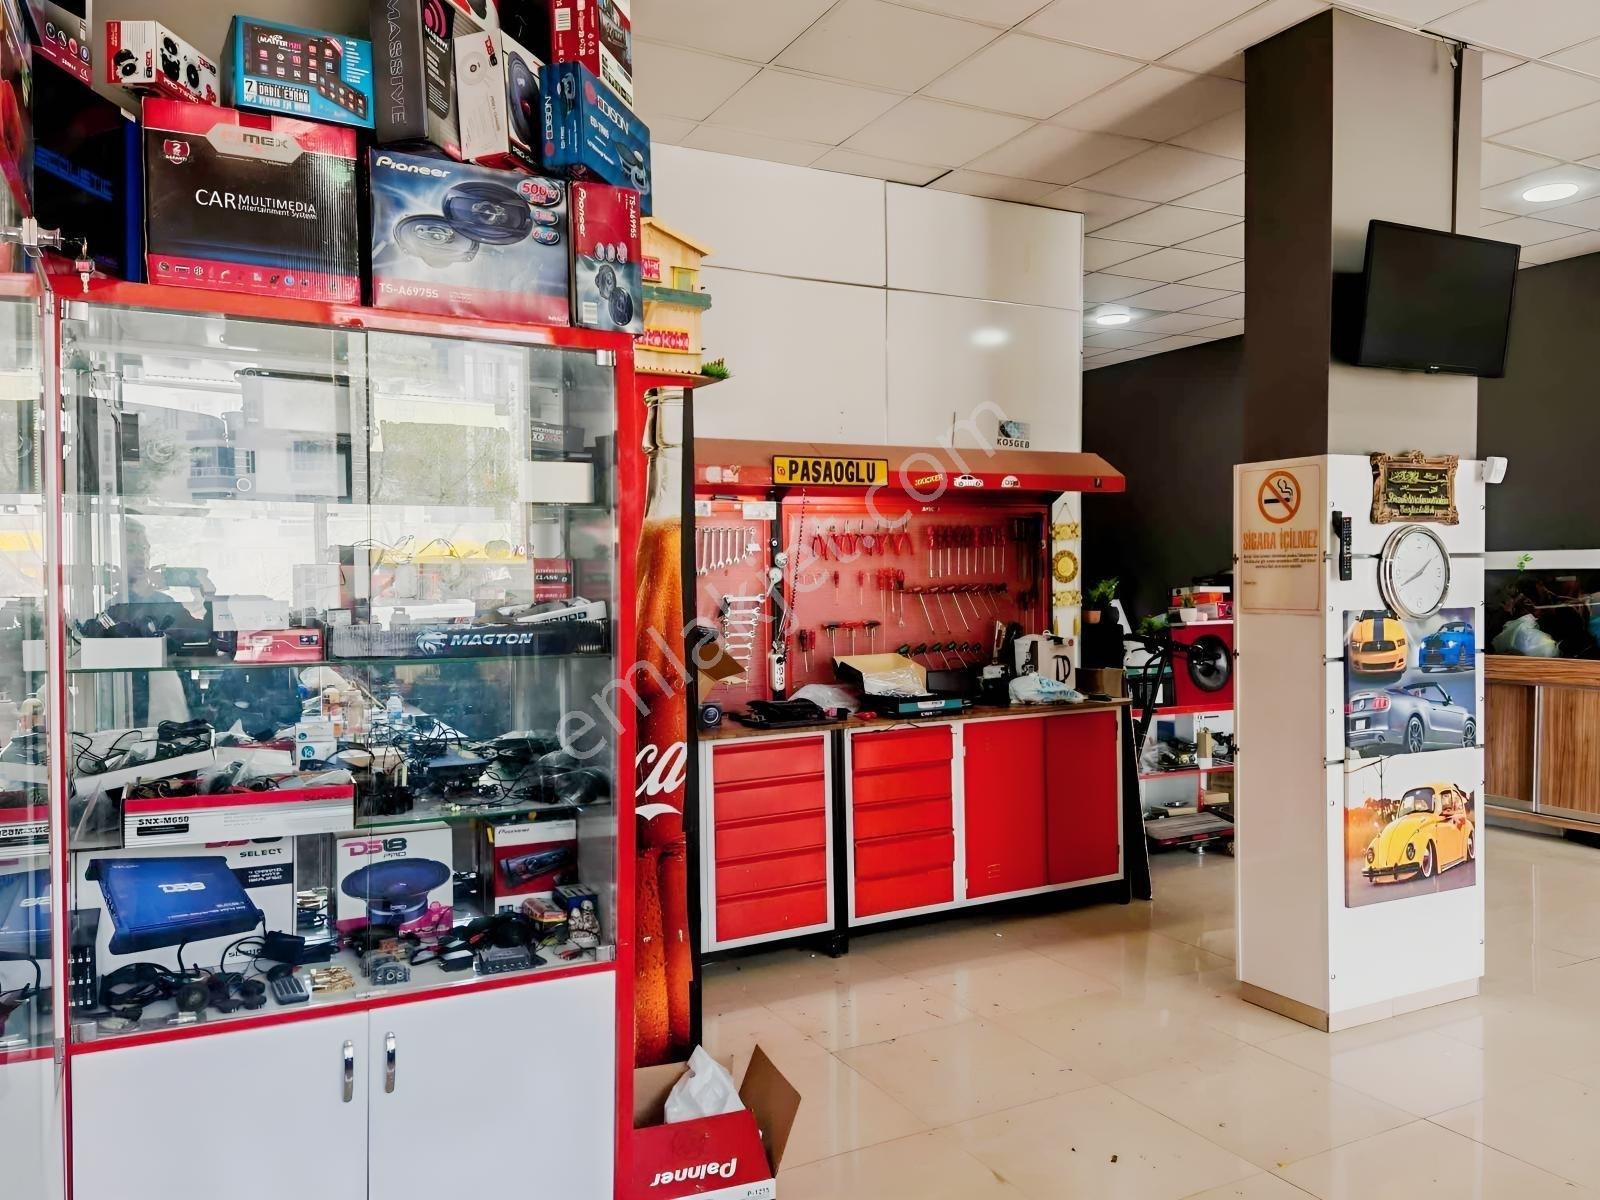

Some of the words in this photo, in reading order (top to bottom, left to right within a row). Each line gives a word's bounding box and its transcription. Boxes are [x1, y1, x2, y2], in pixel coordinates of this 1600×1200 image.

[375, 156, 451, 178] Pioneer
[195, 189, 237, 210] CAR
[238, 194, 316, 214] MULTIMEDIA
[577, 188, 586, 237] Pioneer
[997, 438, 1030, 449] KOSGEB
[450, 632, 534, 646] MAGTON
[239, 848, 283, 858] SELECT
[341, 837, 407, 857] DS18
